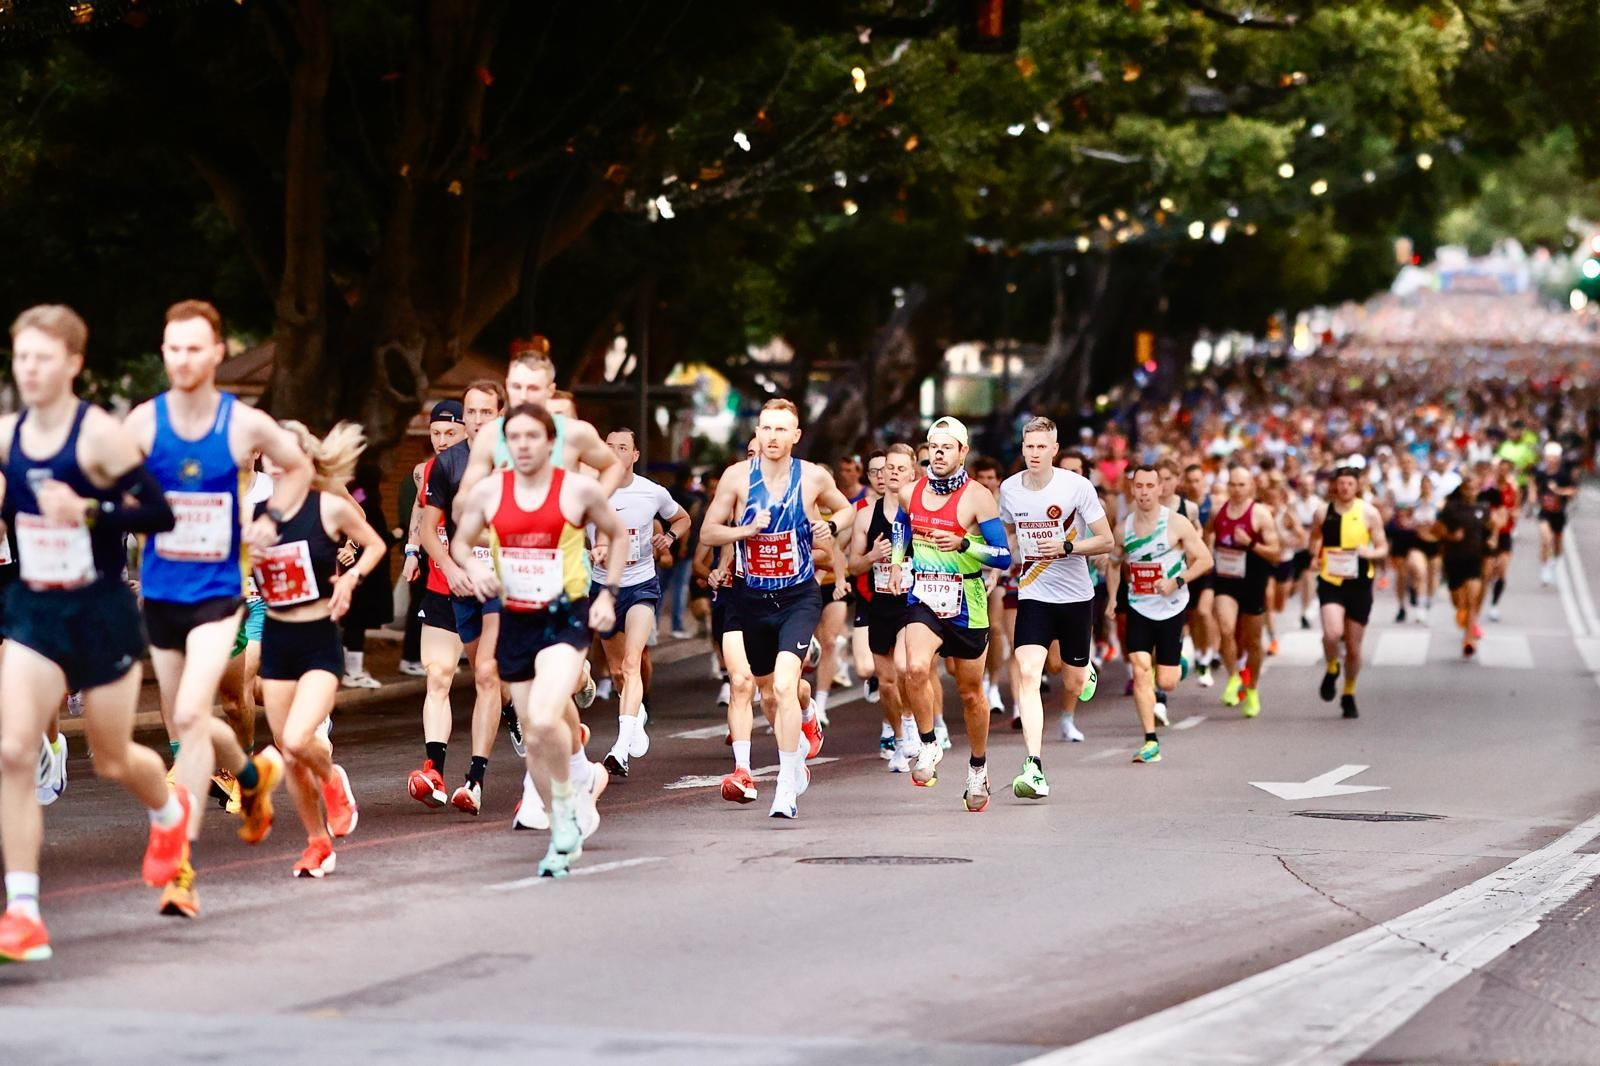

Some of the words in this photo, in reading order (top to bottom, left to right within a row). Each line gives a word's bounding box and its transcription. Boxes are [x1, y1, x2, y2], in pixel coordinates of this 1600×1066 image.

[1026, 530, 1053, 539] 14600
[758, 544, 778, 554] 269
[923, 584, 950, 593] 15179
